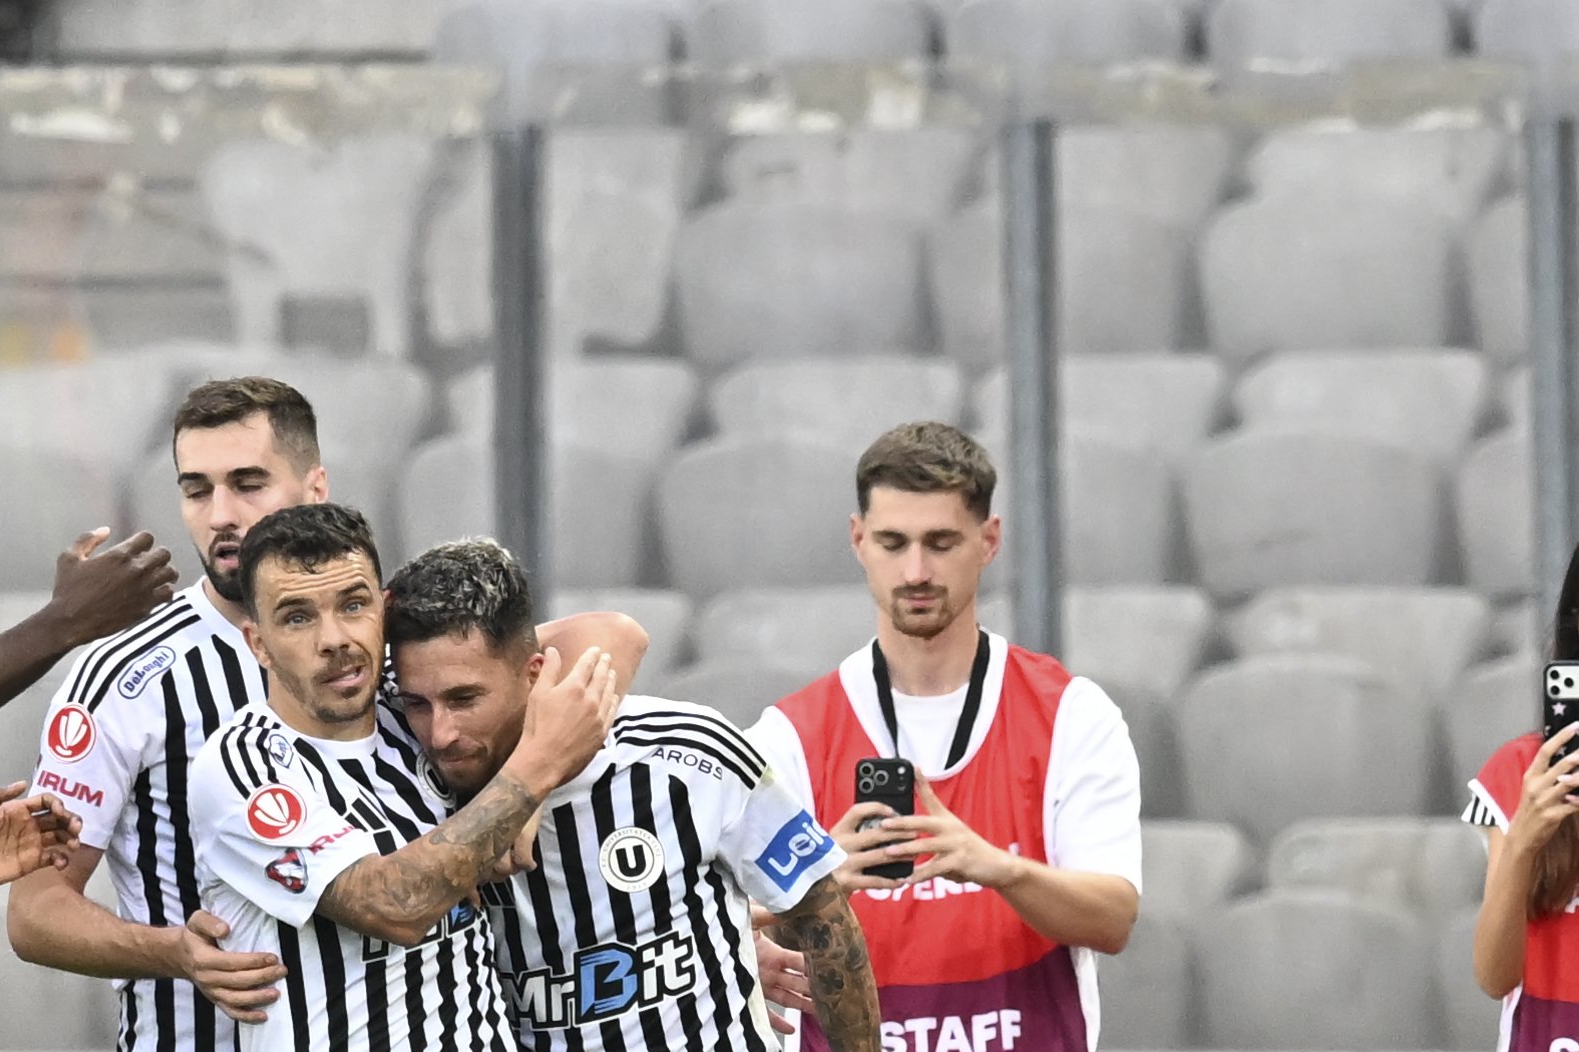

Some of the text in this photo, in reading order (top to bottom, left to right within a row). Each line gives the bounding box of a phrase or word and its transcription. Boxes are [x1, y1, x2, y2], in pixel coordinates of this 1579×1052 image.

[124, 651, 170, 692] DeLonghi
[652, 747, 723, 781] AROBS
[37, 770, 104, 808] IRUM
[615, 844, 647, 878] U
[501, 938, 693, 1024] MrBit
